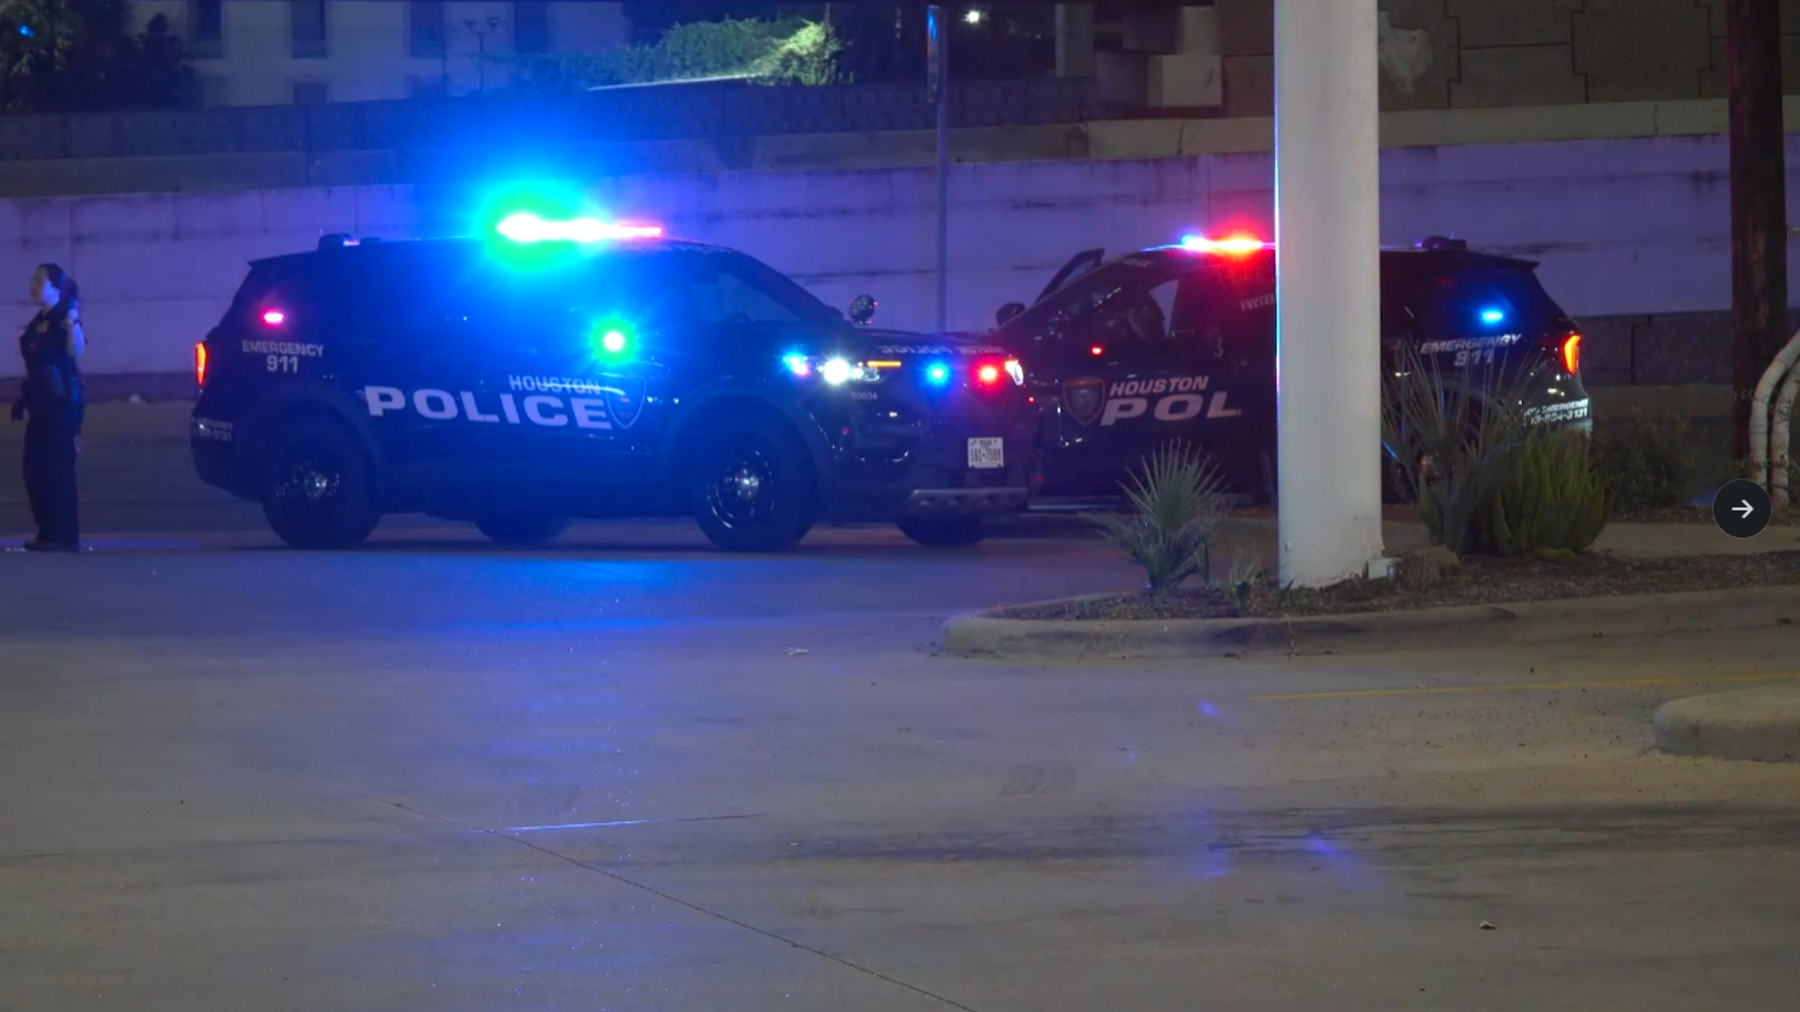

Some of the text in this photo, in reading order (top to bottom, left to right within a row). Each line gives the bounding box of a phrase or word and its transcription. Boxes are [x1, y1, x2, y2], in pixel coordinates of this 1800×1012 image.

[241, 340, 324, 357] EMERGENCY
[1420, 334, 1522, 354] EMERGENCY
[266, 355, 299, 373] 911
[1454, 348, 1496, 367] 911
[508, 374, 600, 395] HOUSTON
[1109, 375, 1209, 397] HOUSTON
[364, 385, 613, 430] POLICE
[1100, 391, 1242, 426] POL
